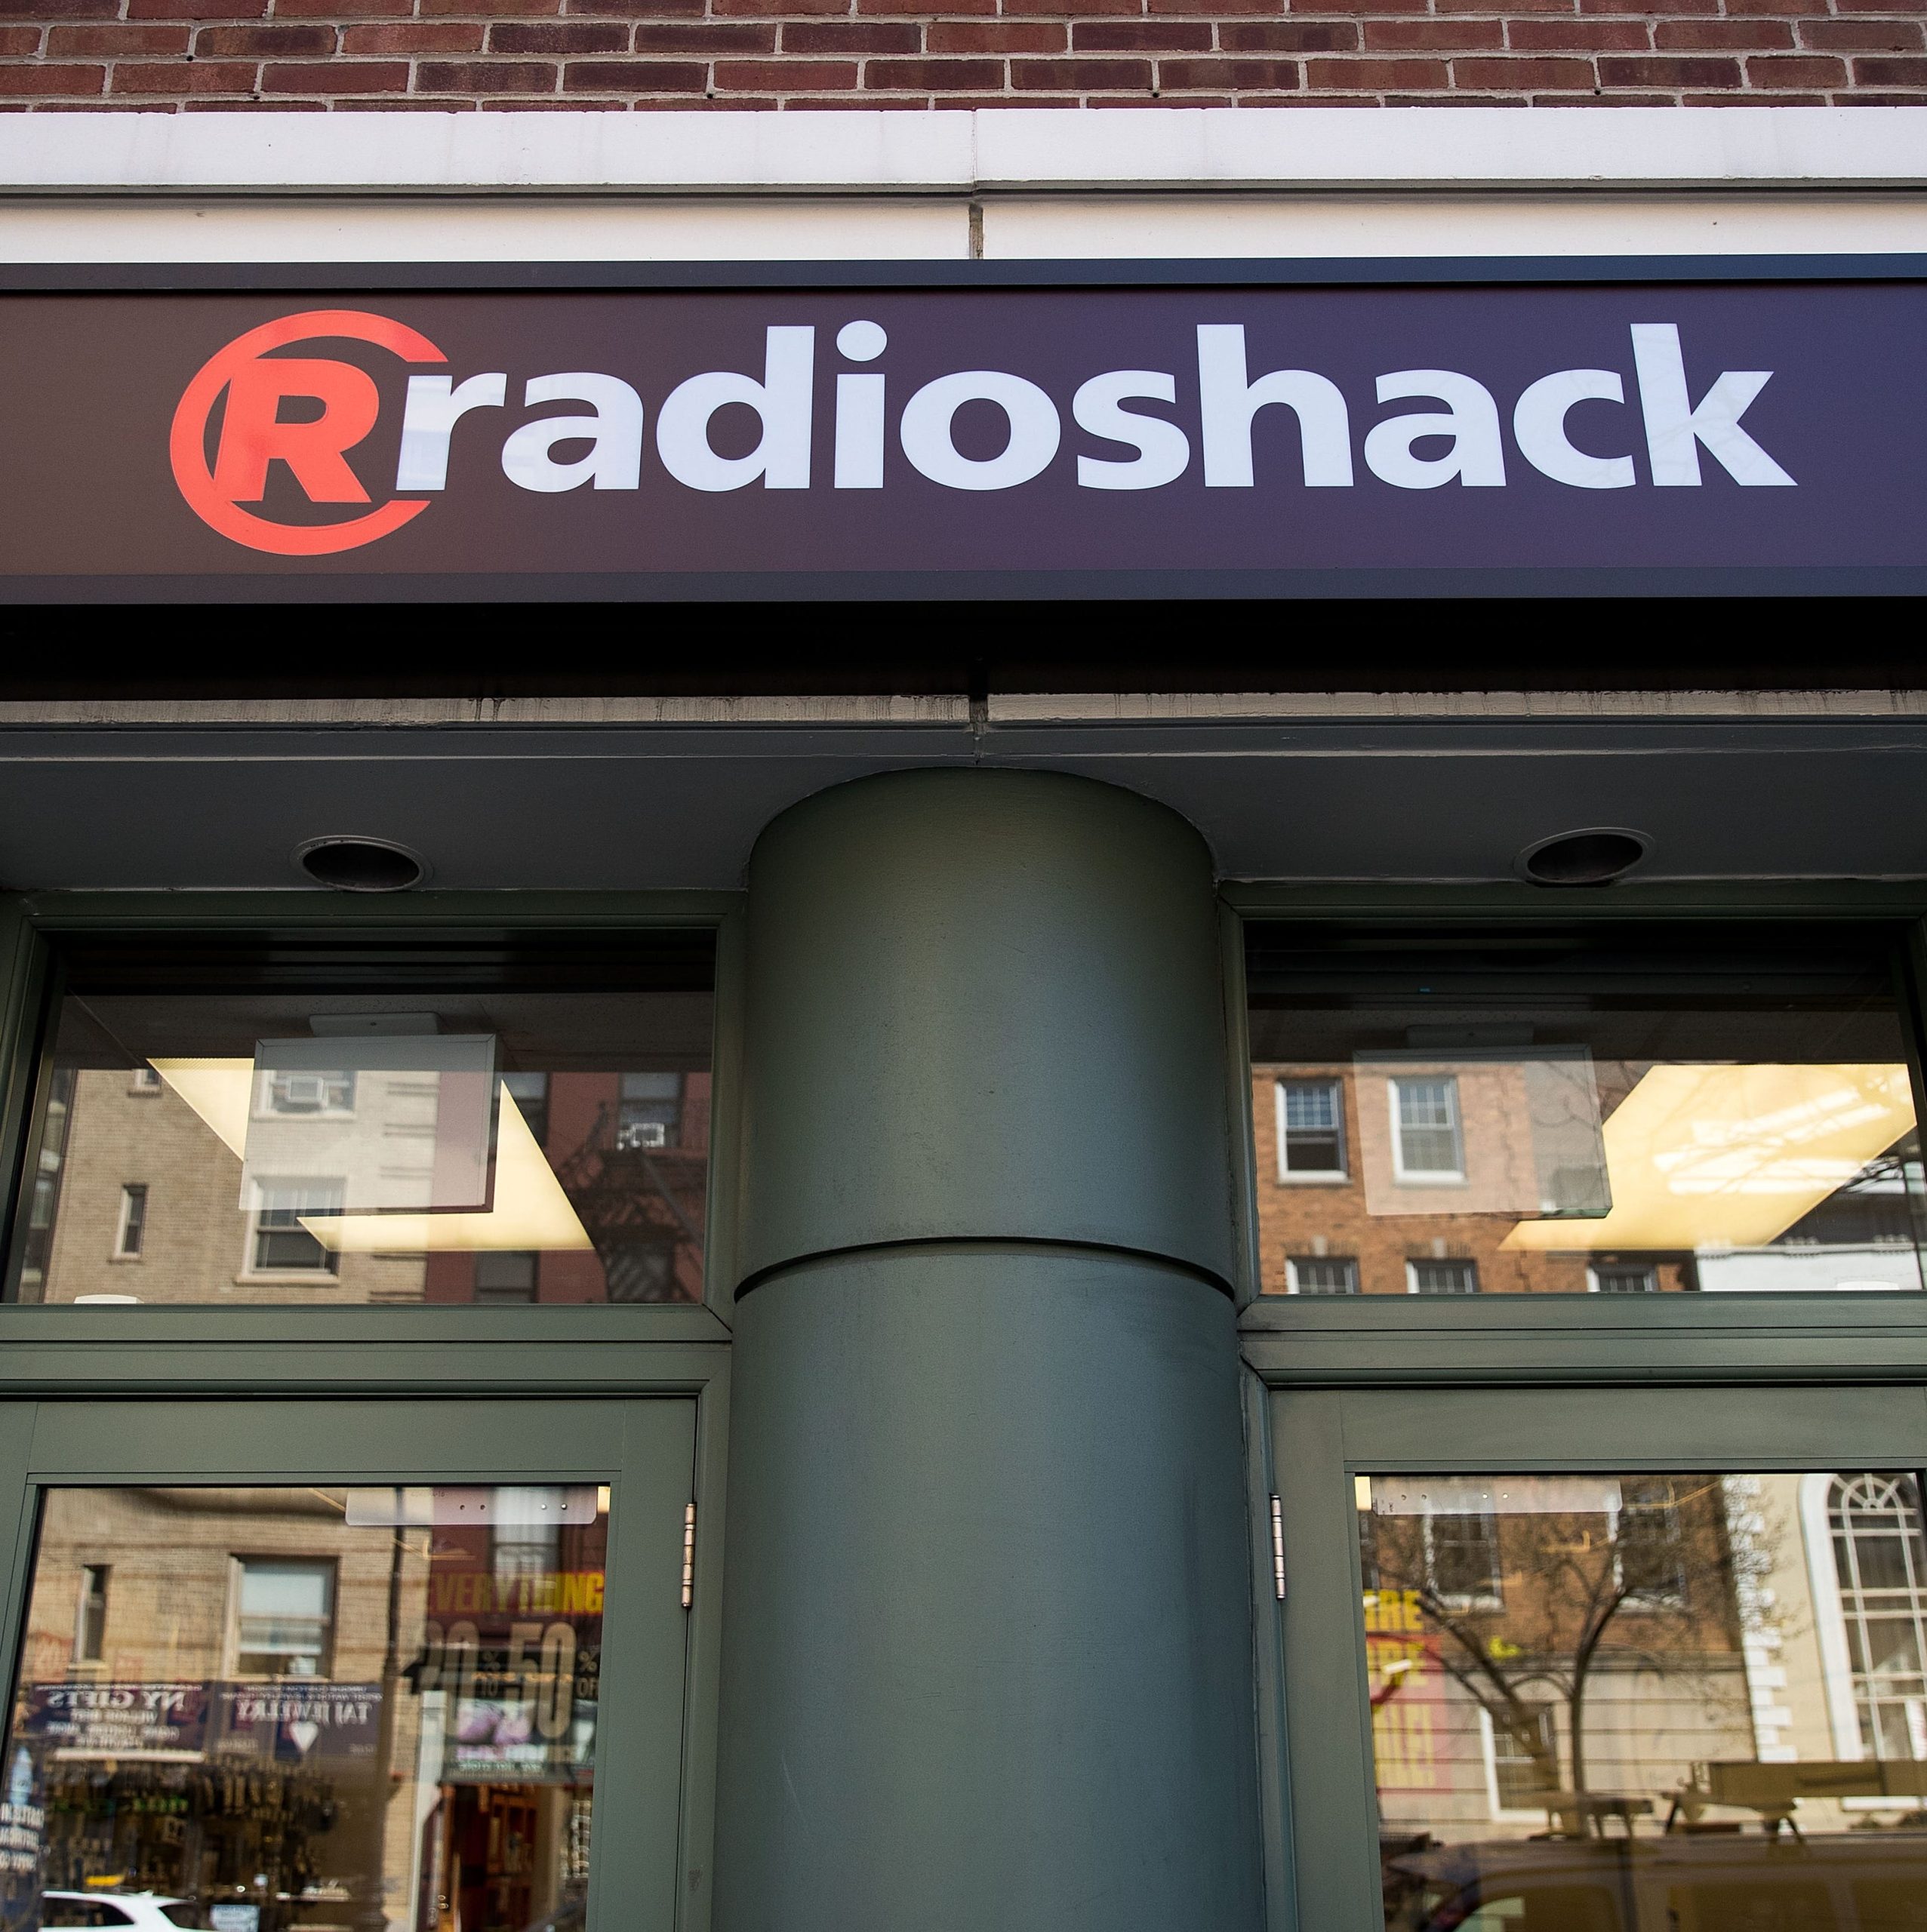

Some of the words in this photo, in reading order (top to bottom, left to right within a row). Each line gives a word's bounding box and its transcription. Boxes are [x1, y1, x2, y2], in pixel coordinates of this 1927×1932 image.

[396, 320, 1799, 492] radioshack
[428, 1571, 604, 1614] VERYTHING
[505, 1622, 577, 1737] 50
